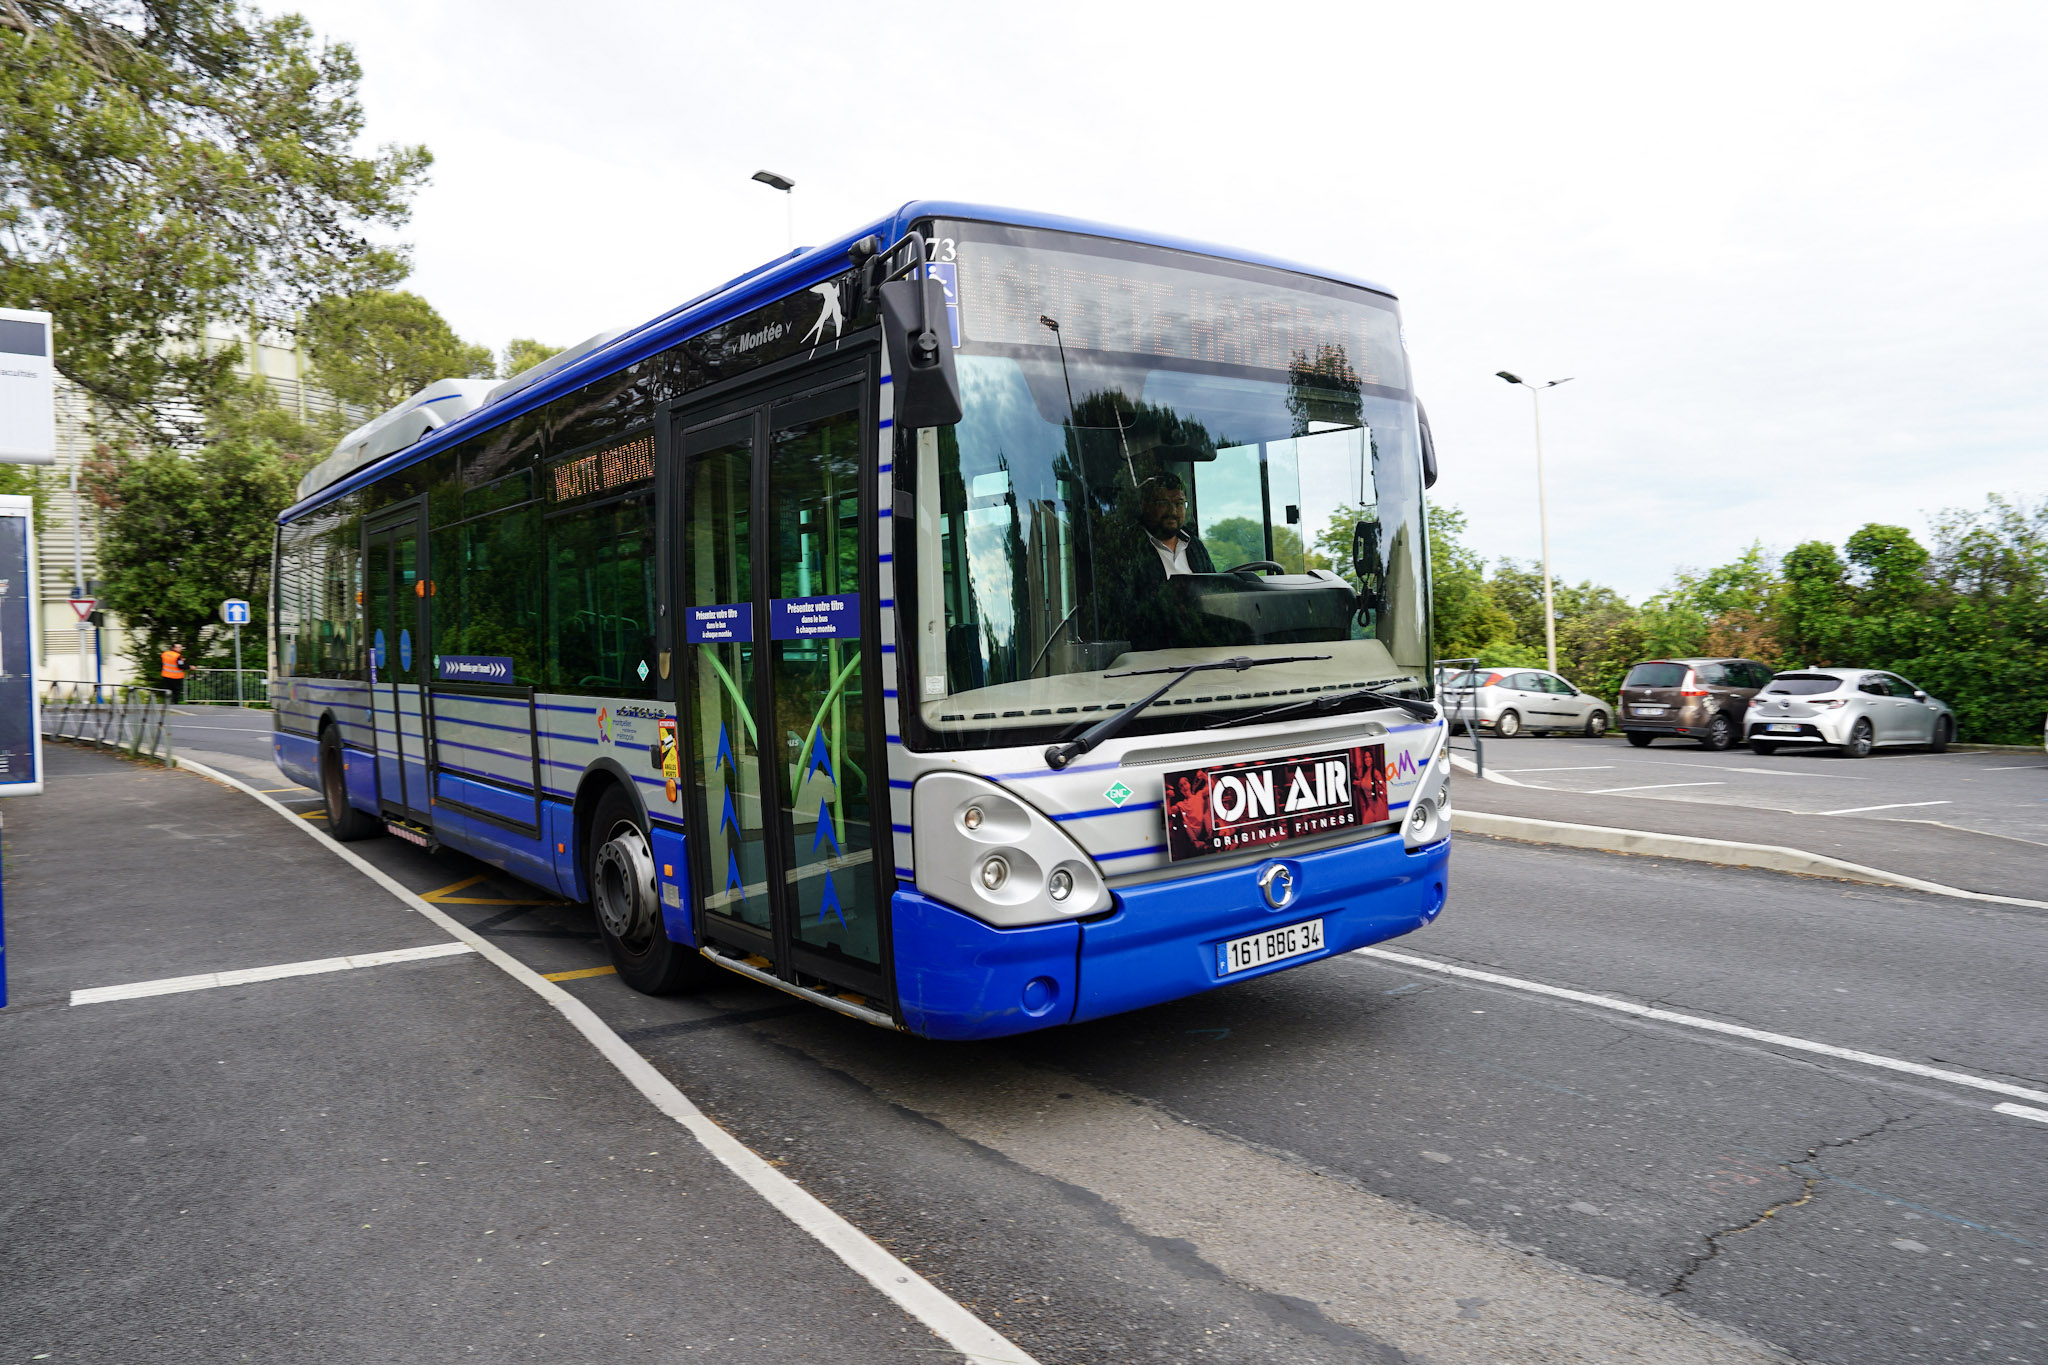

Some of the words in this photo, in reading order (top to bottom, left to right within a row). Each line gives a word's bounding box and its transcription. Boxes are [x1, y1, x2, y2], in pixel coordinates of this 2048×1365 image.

[957, 252, 1175, 356] NAVETTE
[1190, 288, 1379, 385] HANDBALL
[739, 321, 783, 353] Montée
[554, 454, 599, 501] NAVETTE
[787, 602, 815, 614] Présentez
[815, 601, 831, 612] votre
[831, 600, 844, 611] titre
[801, 615, 814, 623] dans
[813, 614, 818, 623] le
[818, 614, 829, 622] bus
[796, 625, 800, 634] à
[800, 625, 817, 635] chaque
[817, 624, 837, 633] montée
[664, 763, 677, 771] ANGLES
[1110, 788, 1128, 799] GNC
[1212, 769, 1276, 822] ON
[1283, 760, 1350, 813] AIR
[1213, 827, 1287, 848] ORIGINAL
[1295, 813, 1355, 833] FITNESS
[1231, 938, 1261, 967] 161
[1266, 929, 1296, 959] BBG
[1300, 923, 1320, 949] 34
